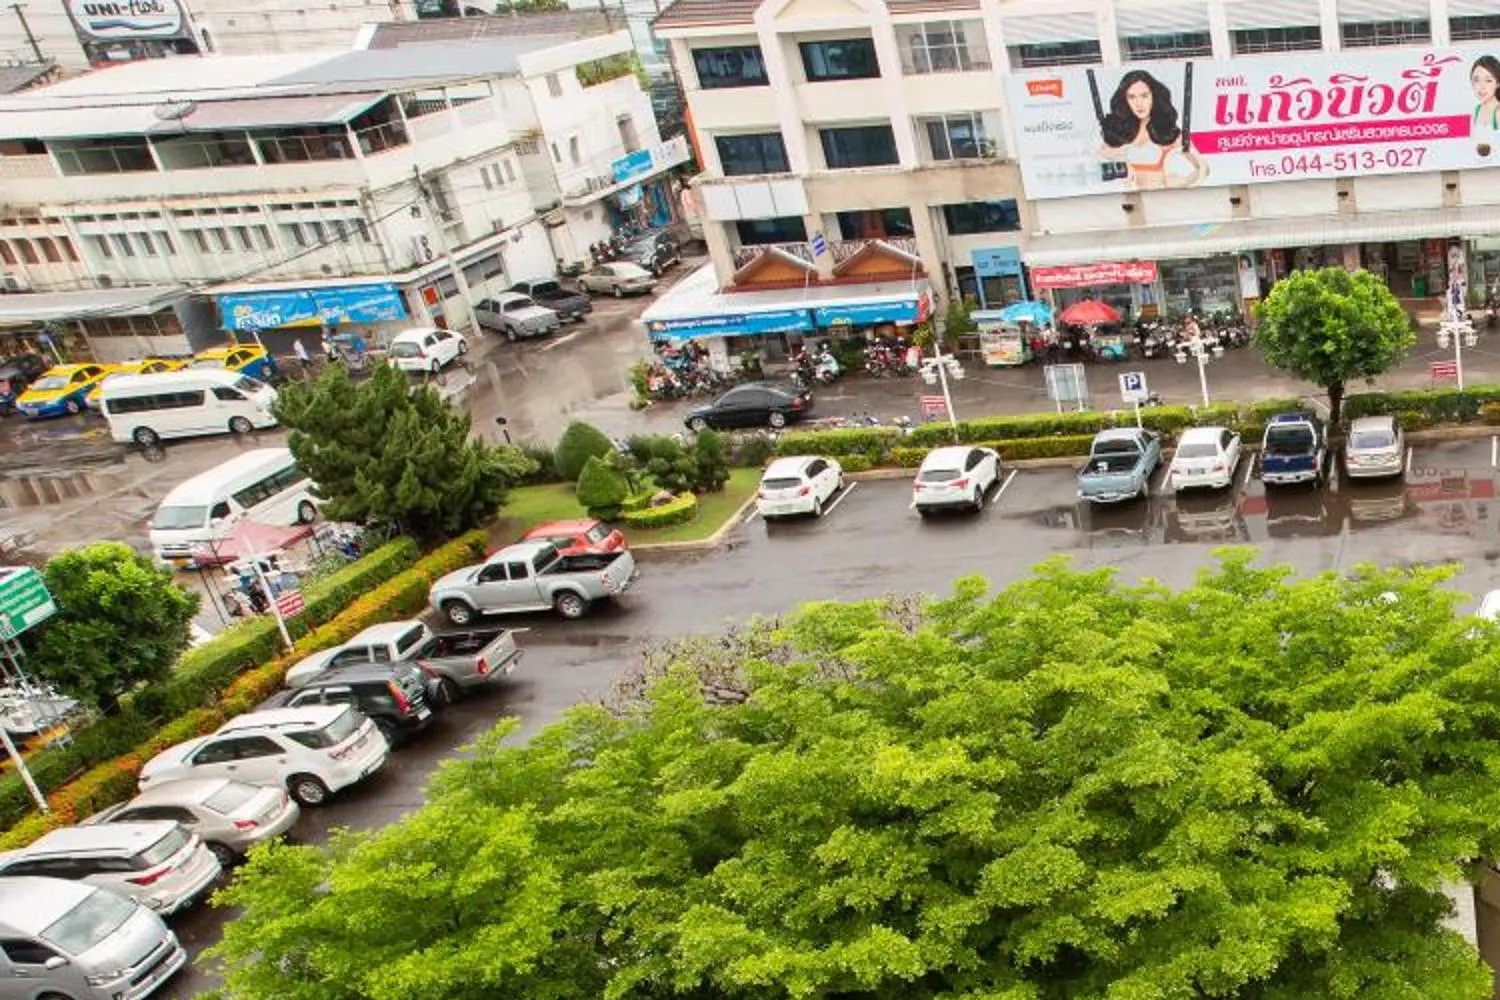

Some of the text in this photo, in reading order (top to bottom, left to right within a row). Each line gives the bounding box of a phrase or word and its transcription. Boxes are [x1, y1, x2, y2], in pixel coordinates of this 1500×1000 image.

[1214, 54, 1464, 126] แก้วบิวตี้
[1127, 375, 1138, 390] P
